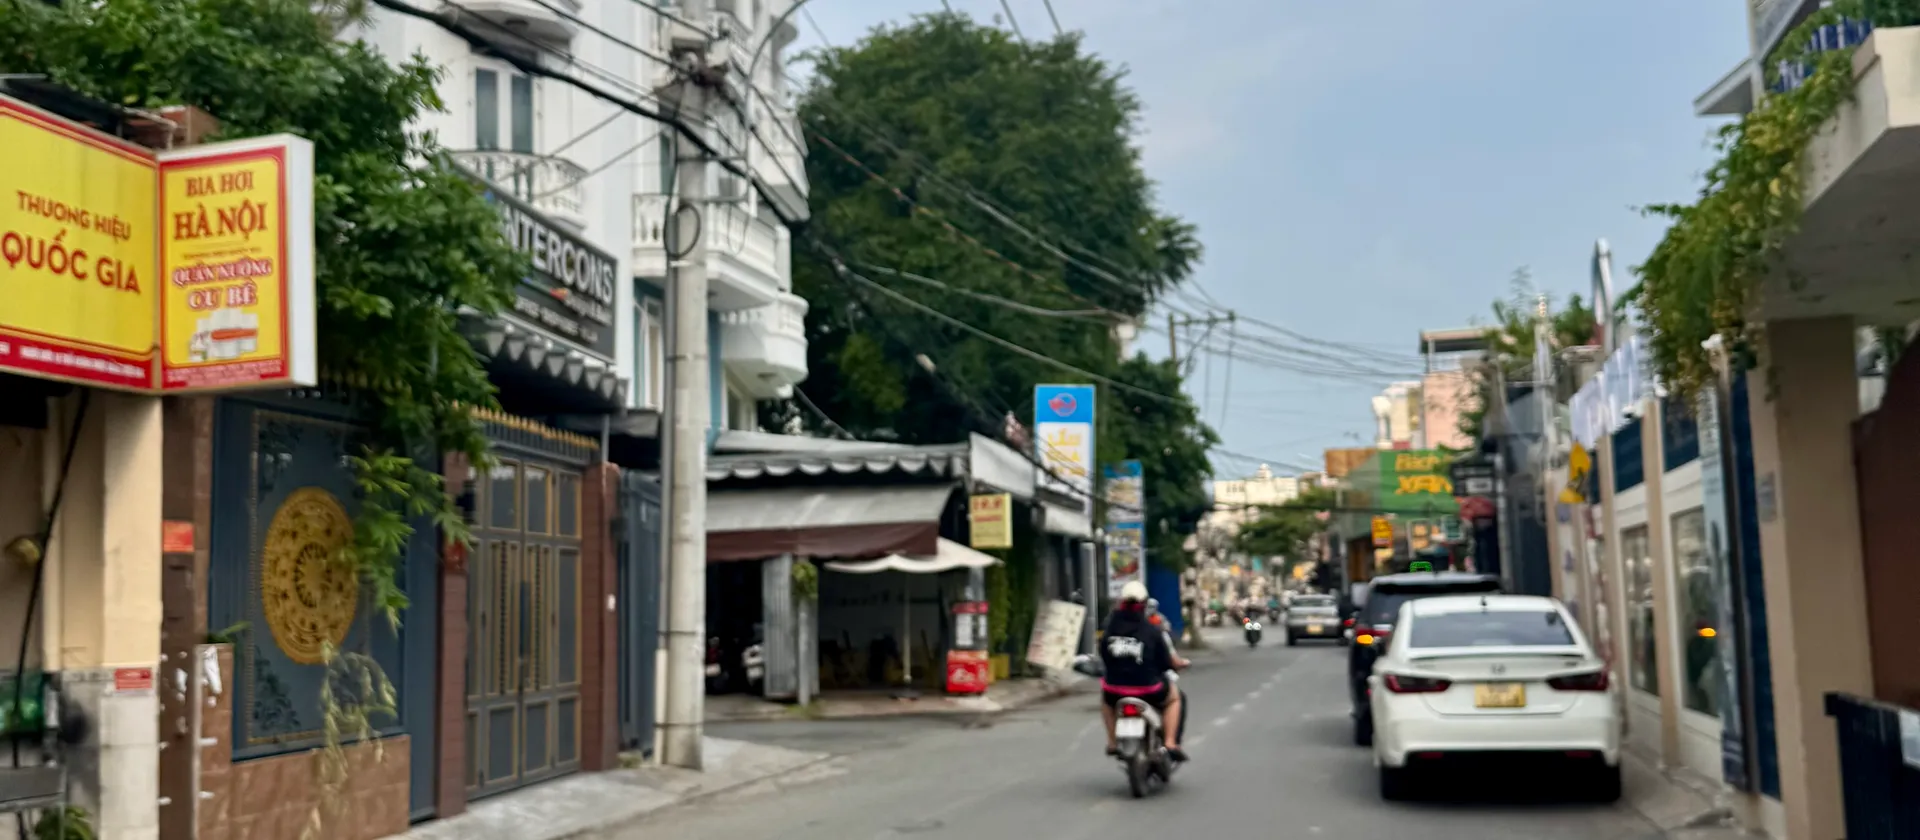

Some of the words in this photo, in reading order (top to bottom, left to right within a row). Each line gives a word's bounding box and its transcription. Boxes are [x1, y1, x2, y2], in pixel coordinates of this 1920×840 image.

[186, 175, 216, 197] BIA
[94, 213, 131, 244] HIỆU
[173, 202, 213, 241] HÀ
[216, 198, 268, 241] NỘI
[2, 228, 88, 280] QUỐC
[96, 255, 142, 296] GIA
[502, 202, 614, 306] NTERCONS
